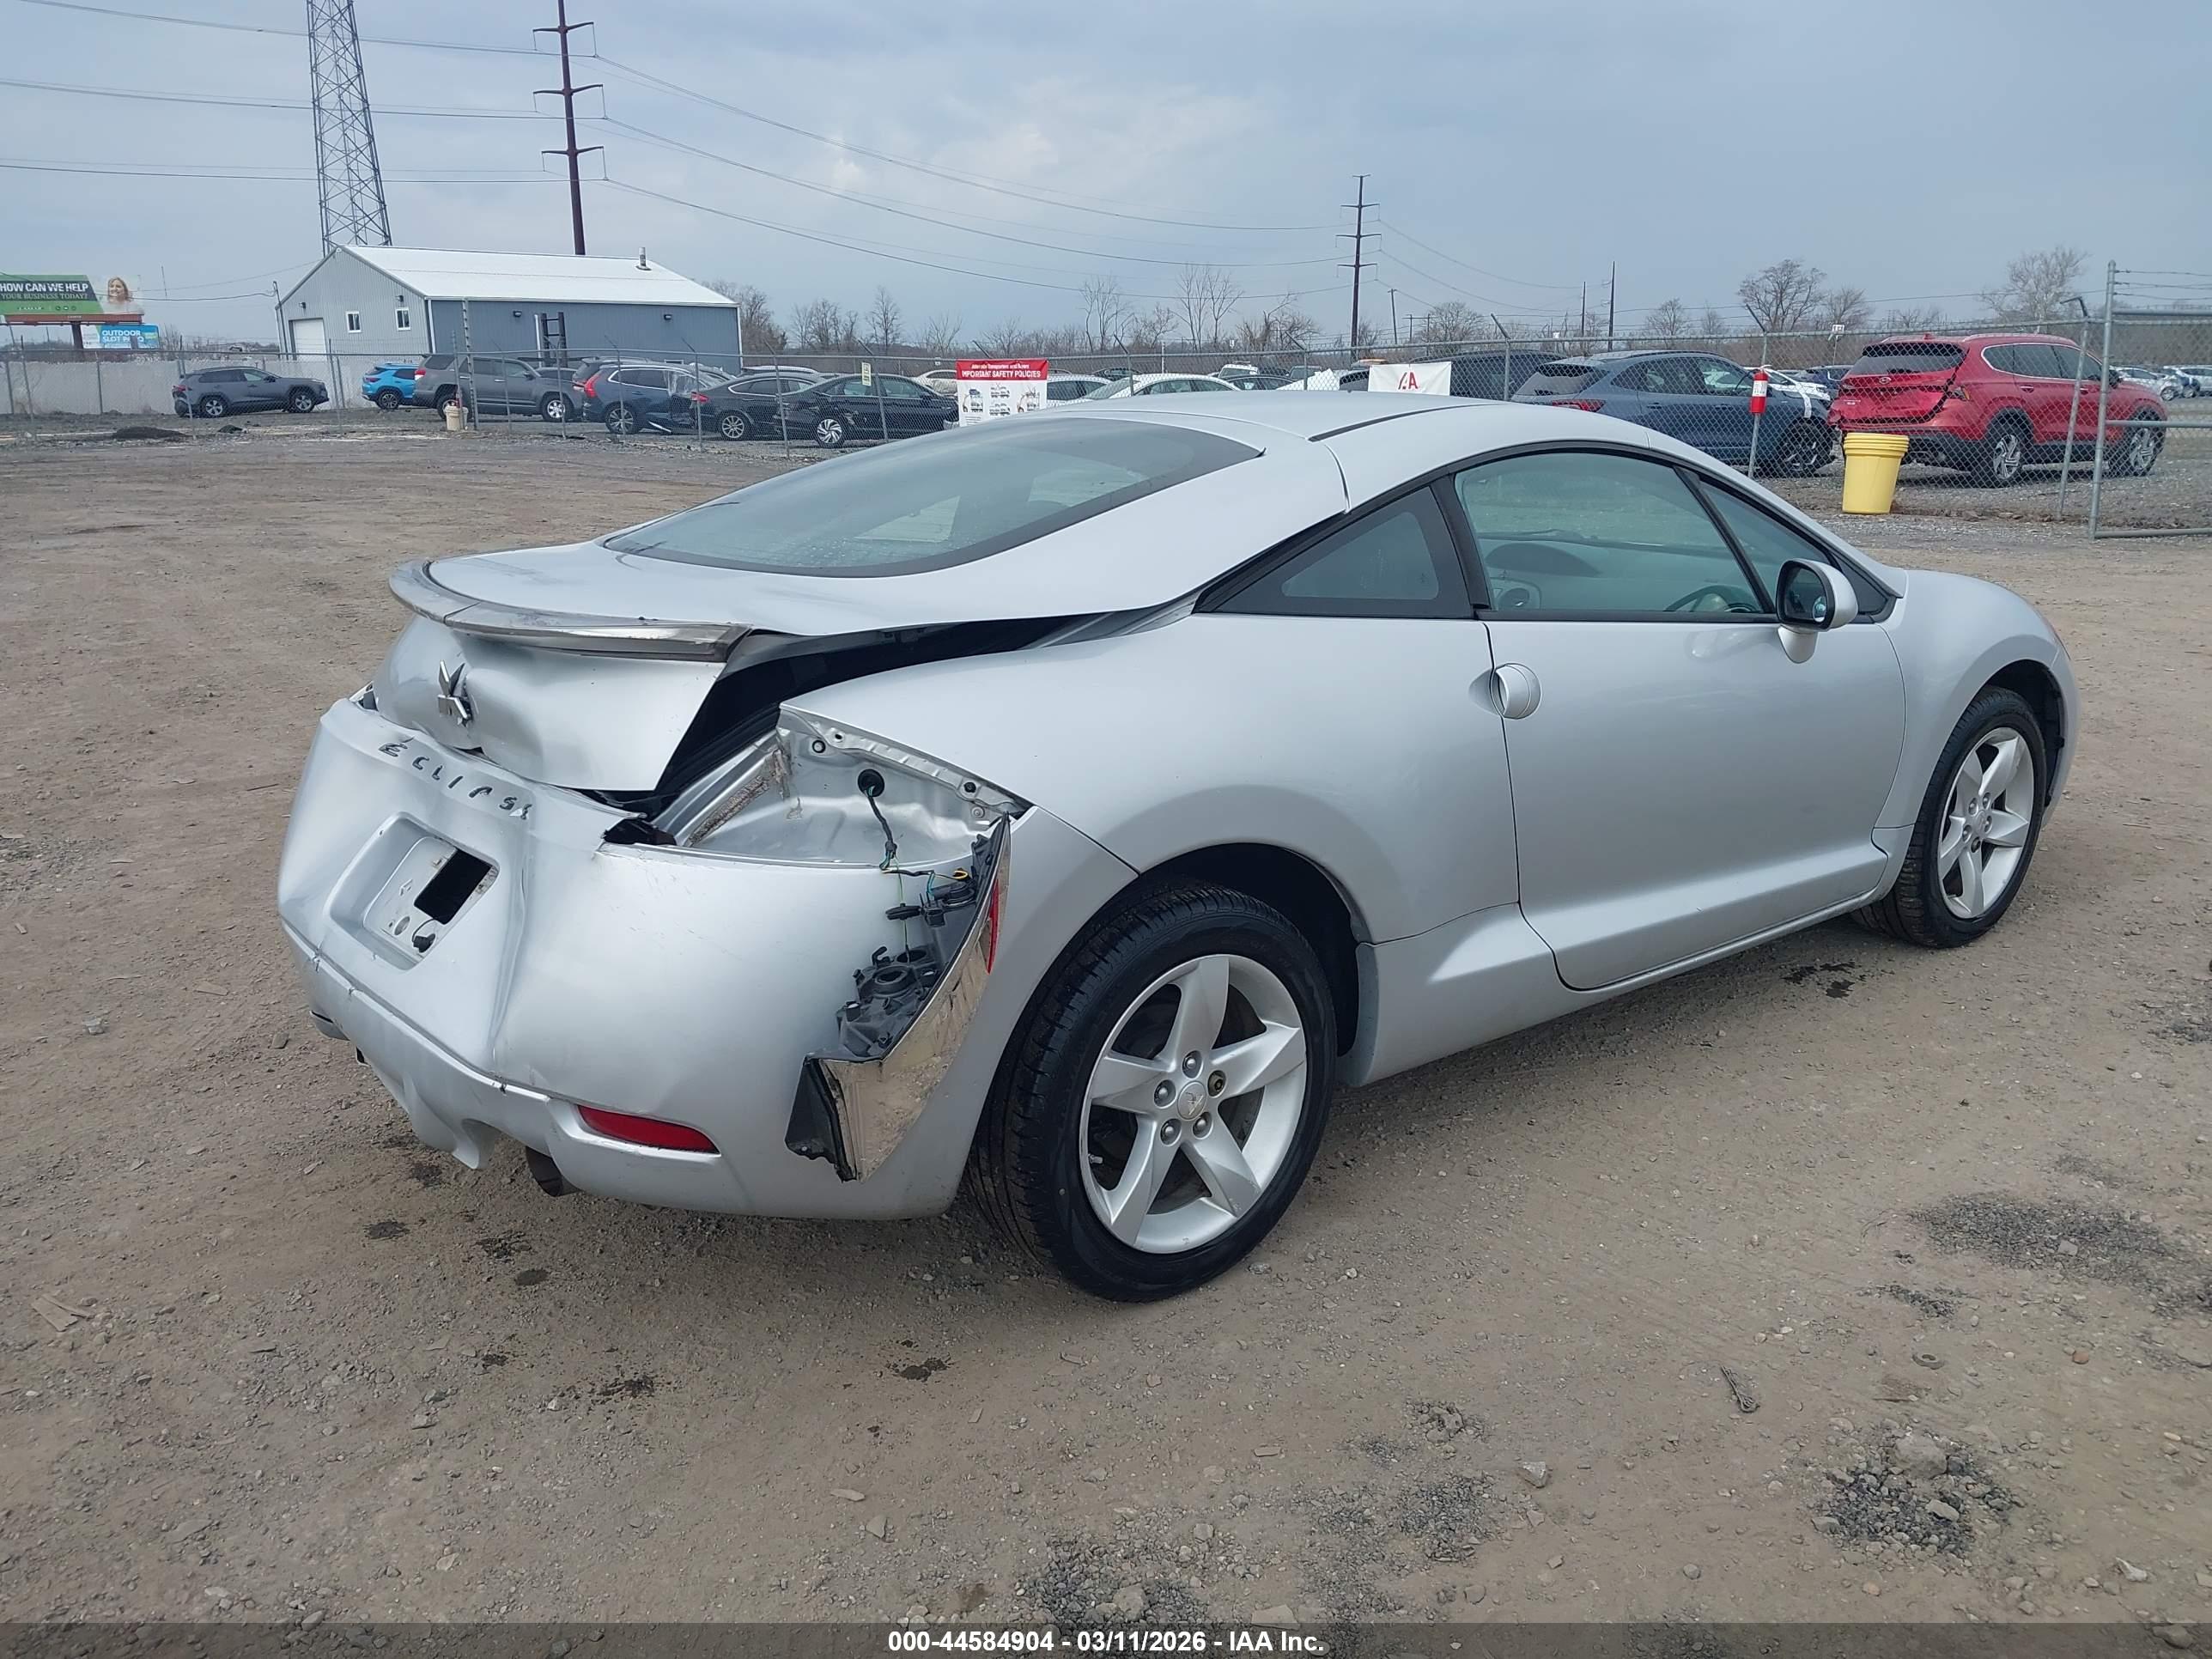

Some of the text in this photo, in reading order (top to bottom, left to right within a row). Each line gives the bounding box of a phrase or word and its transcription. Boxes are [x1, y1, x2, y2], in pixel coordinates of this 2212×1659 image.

[0, 283, 88, 292] HOW CAN WE HELP
